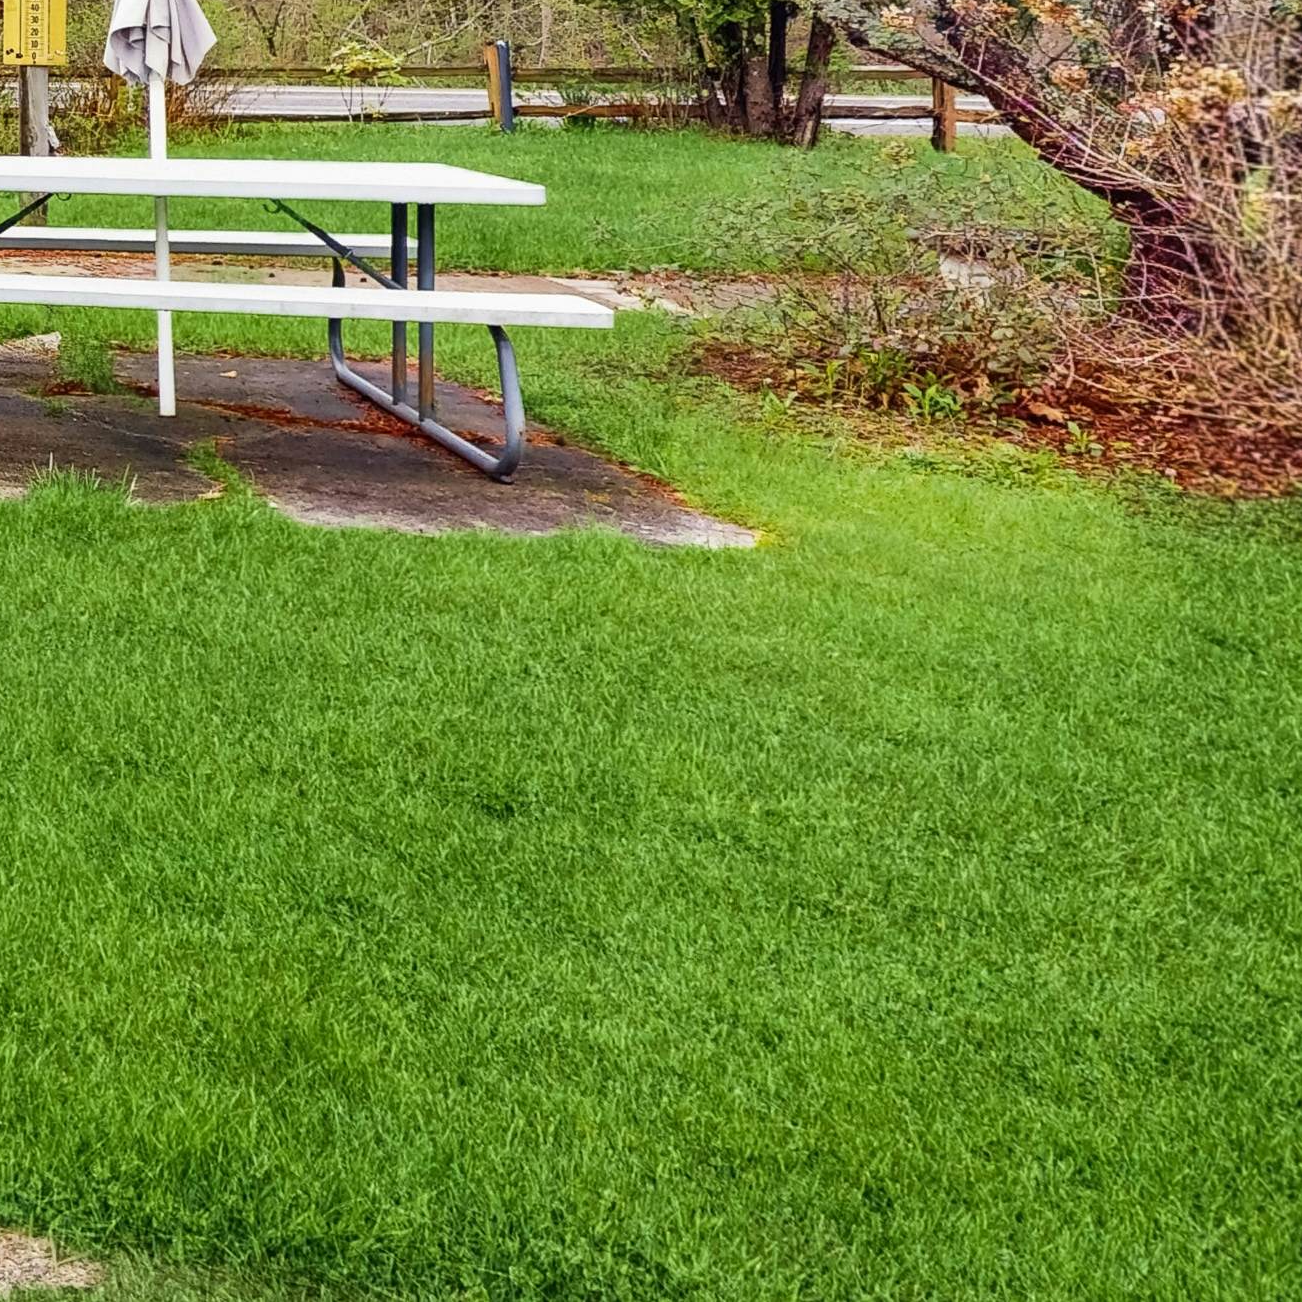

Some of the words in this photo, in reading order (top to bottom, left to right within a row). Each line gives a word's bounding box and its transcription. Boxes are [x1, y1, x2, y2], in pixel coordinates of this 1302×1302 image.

[30, 3, 40, 12] 40
[30, 15, 39, 24] 30
[30, 27, 39, 36] 20
[30, 39, 39, 48] 10
[31, 51, 37, 59] 0
